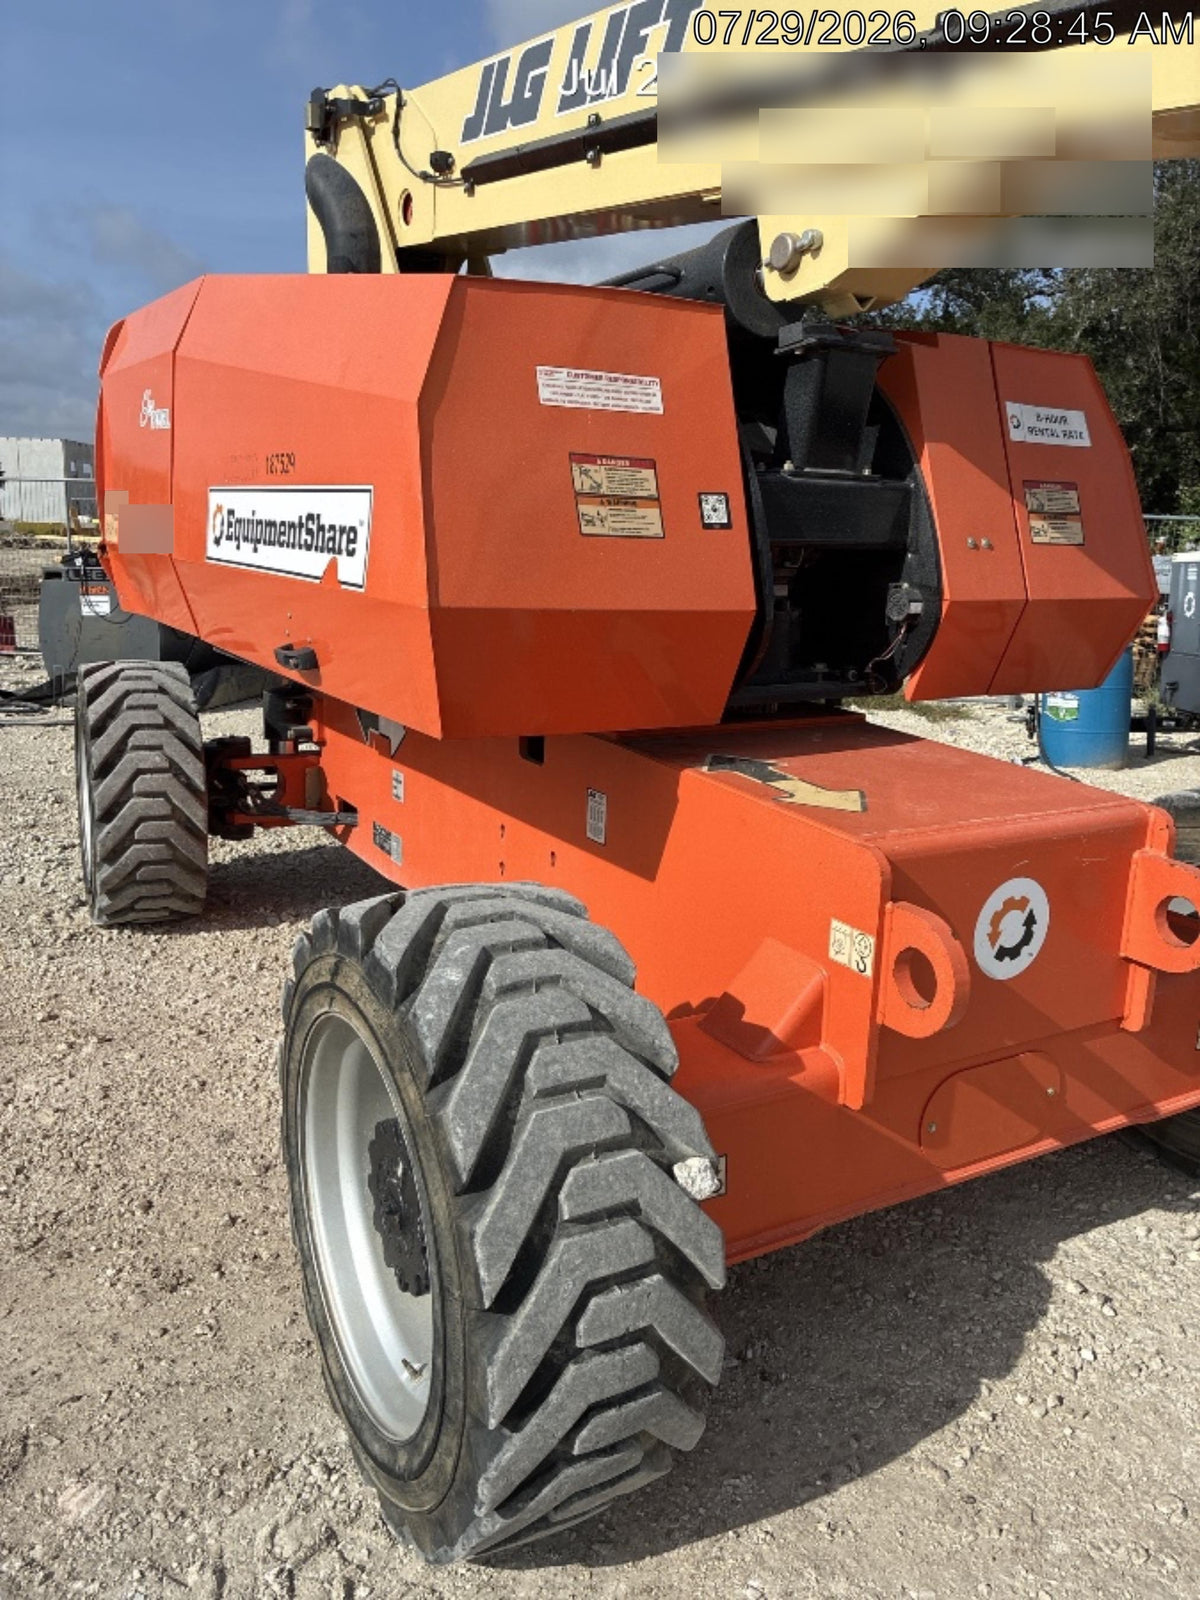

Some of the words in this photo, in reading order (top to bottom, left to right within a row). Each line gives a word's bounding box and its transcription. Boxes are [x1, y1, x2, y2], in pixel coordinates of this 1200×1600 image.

[459, 35, 559, 145] JLG
[555, 0, 706, 116] LIFT
[225, 508, 358, 558] EquipmentShare
